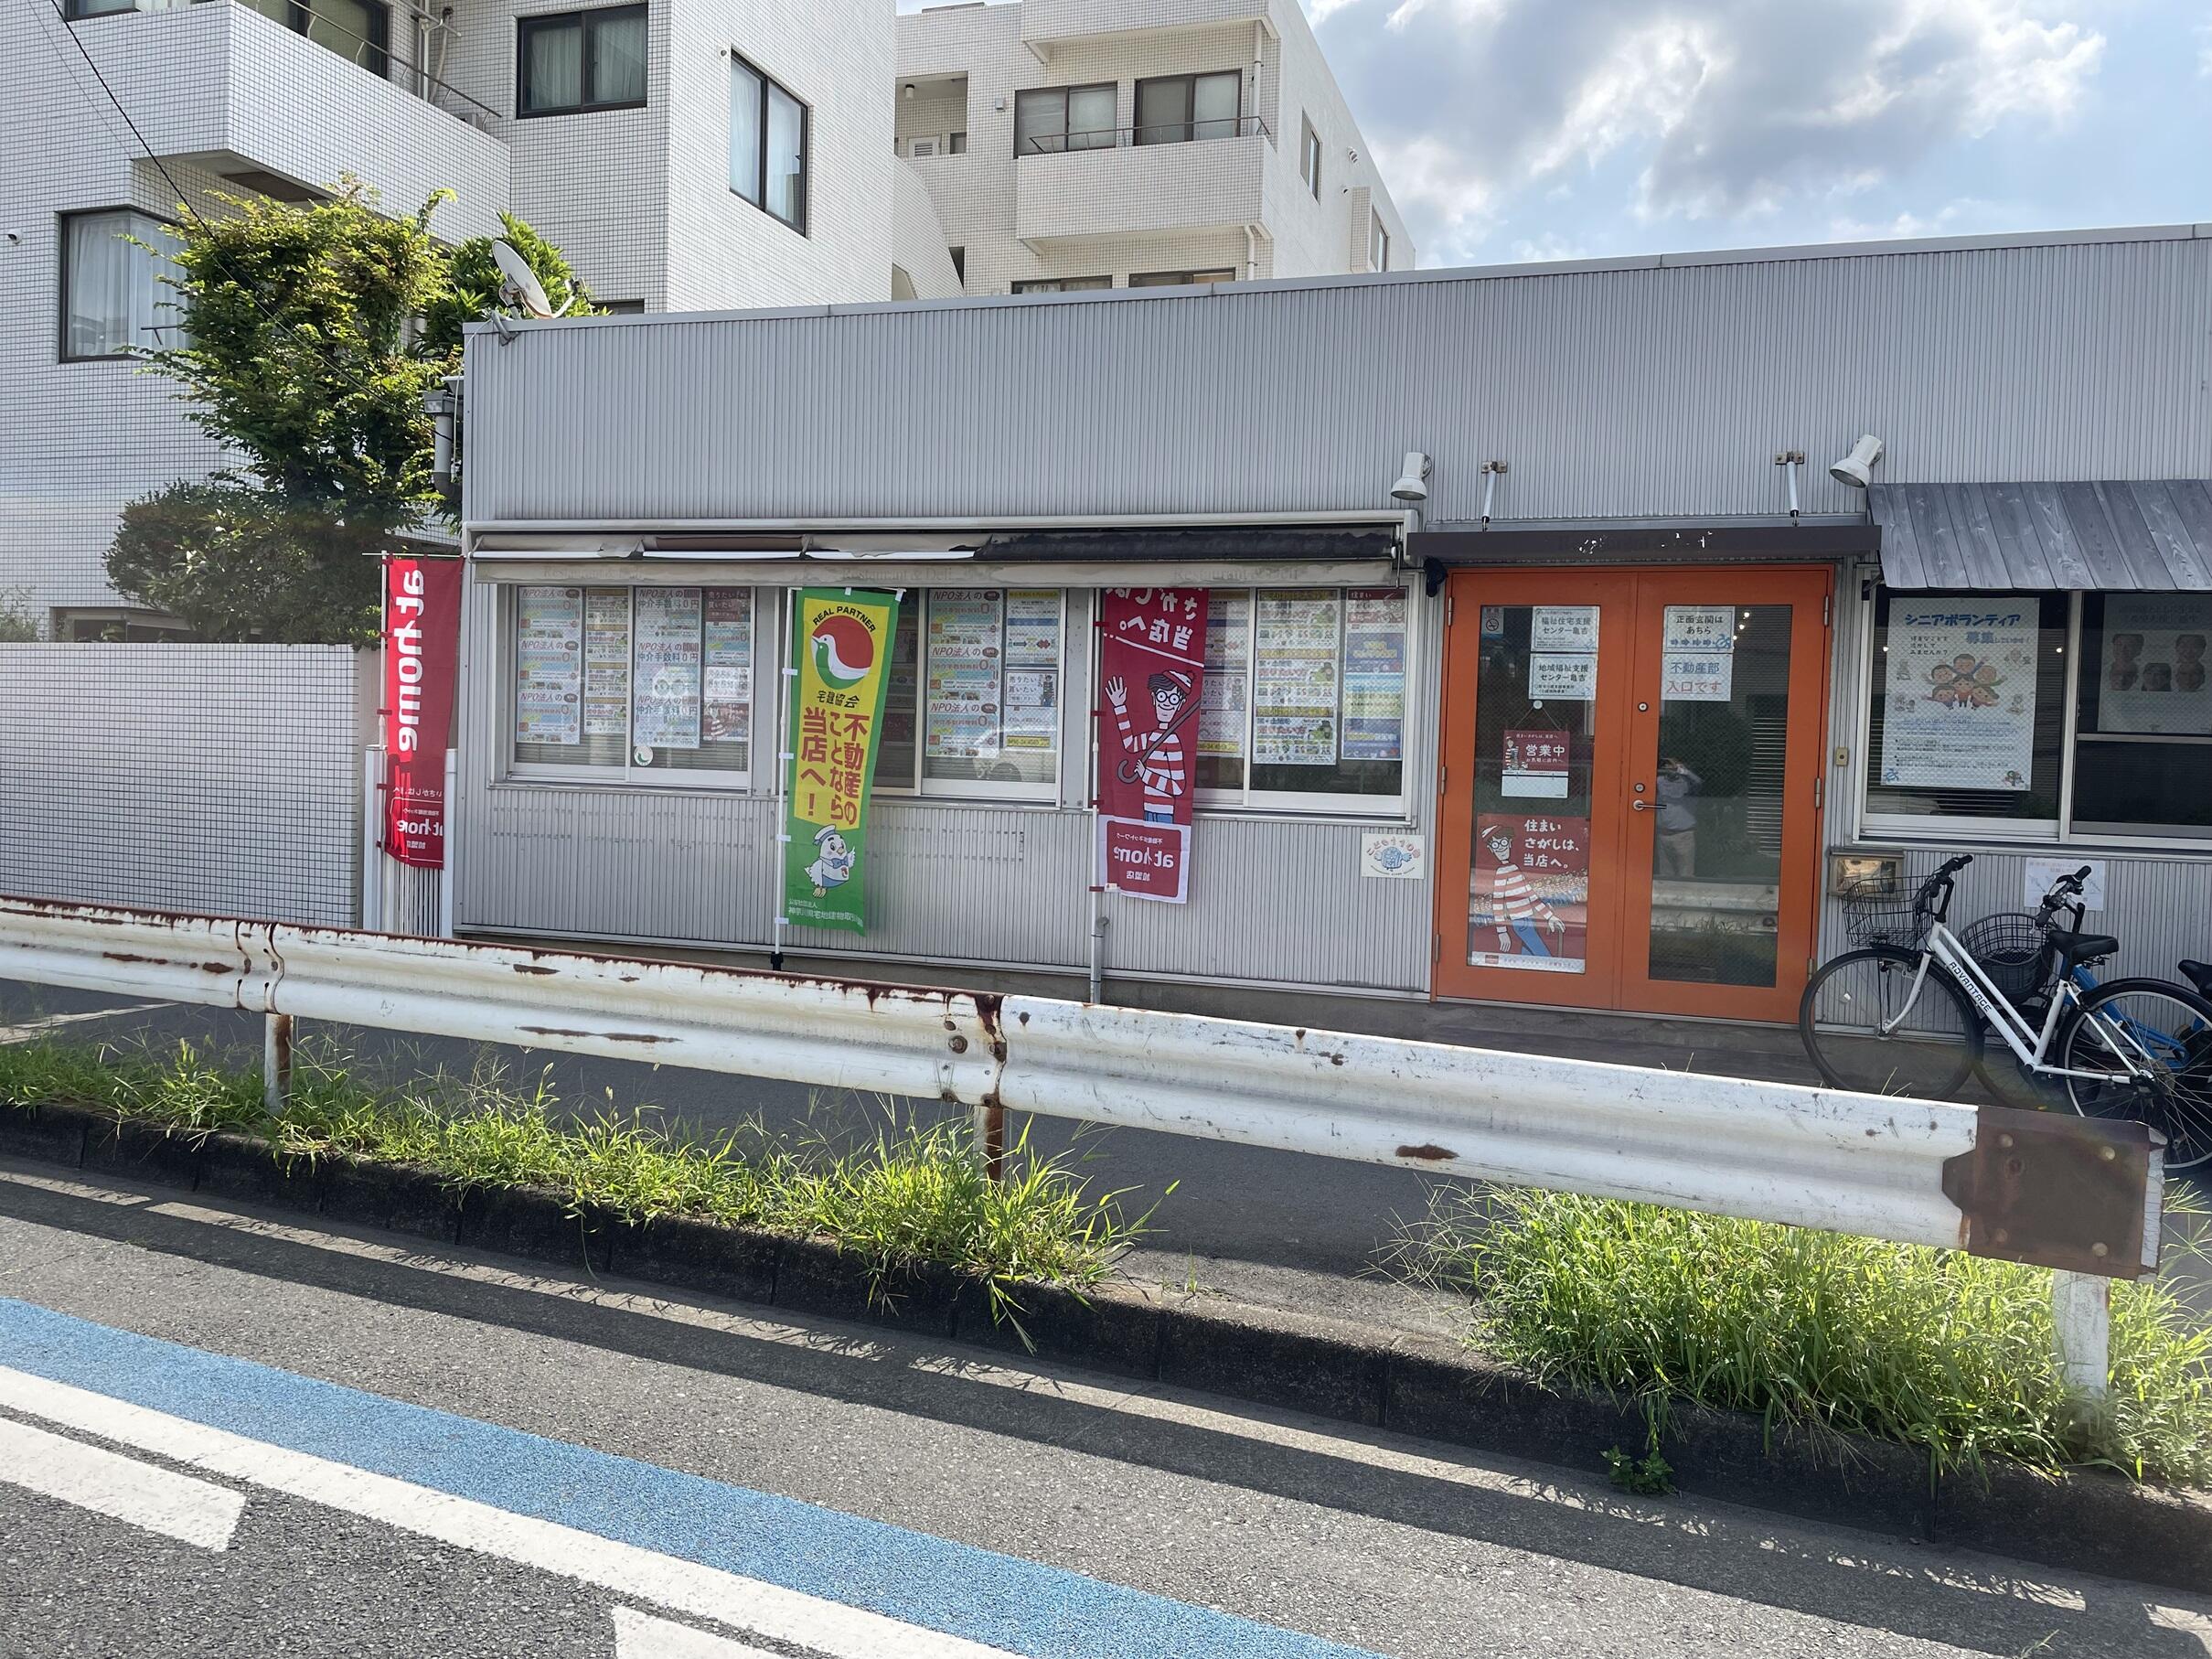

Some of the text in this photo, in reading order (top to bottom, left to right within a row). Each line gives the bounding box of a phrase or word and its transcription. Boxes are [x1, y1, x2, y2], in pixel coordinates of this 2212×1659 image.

[934, 591, 982, 600] NPO法人の
[813, 606, 876, 633] REAL PARTNER
[1676, 615, 1724, 624] 正面玄関は
[1905, 614, 2021, 627] シニアボランティア
[1686, 626, 1712, 635] あちら
[932, 647, 981, 658] NPO法人の
[1538, 664, 1588, 672] 地域福祉支援
[1670, 662, 1720, 674] 不動産部
[1667, 680, 1723, 693] 入口です
[817, 690, 860, 709] 宅建協会
[931, 703, 980, 712] NPO法人の
[1525, 744, 1565, 757] 営業中
[800, 706, 828, 816] 当店へ！
[829, 712, 843, 819] ことなら
[843, 713, 870, 825] 不動産の
[1524, 819, 1561, 832] 住まい
[1524, 838, 1579, 851] さがしは、
[1523, 853, 1568, 869] 当店へ。
[1949, 961, 1992, 1012] ADVANTAGE
